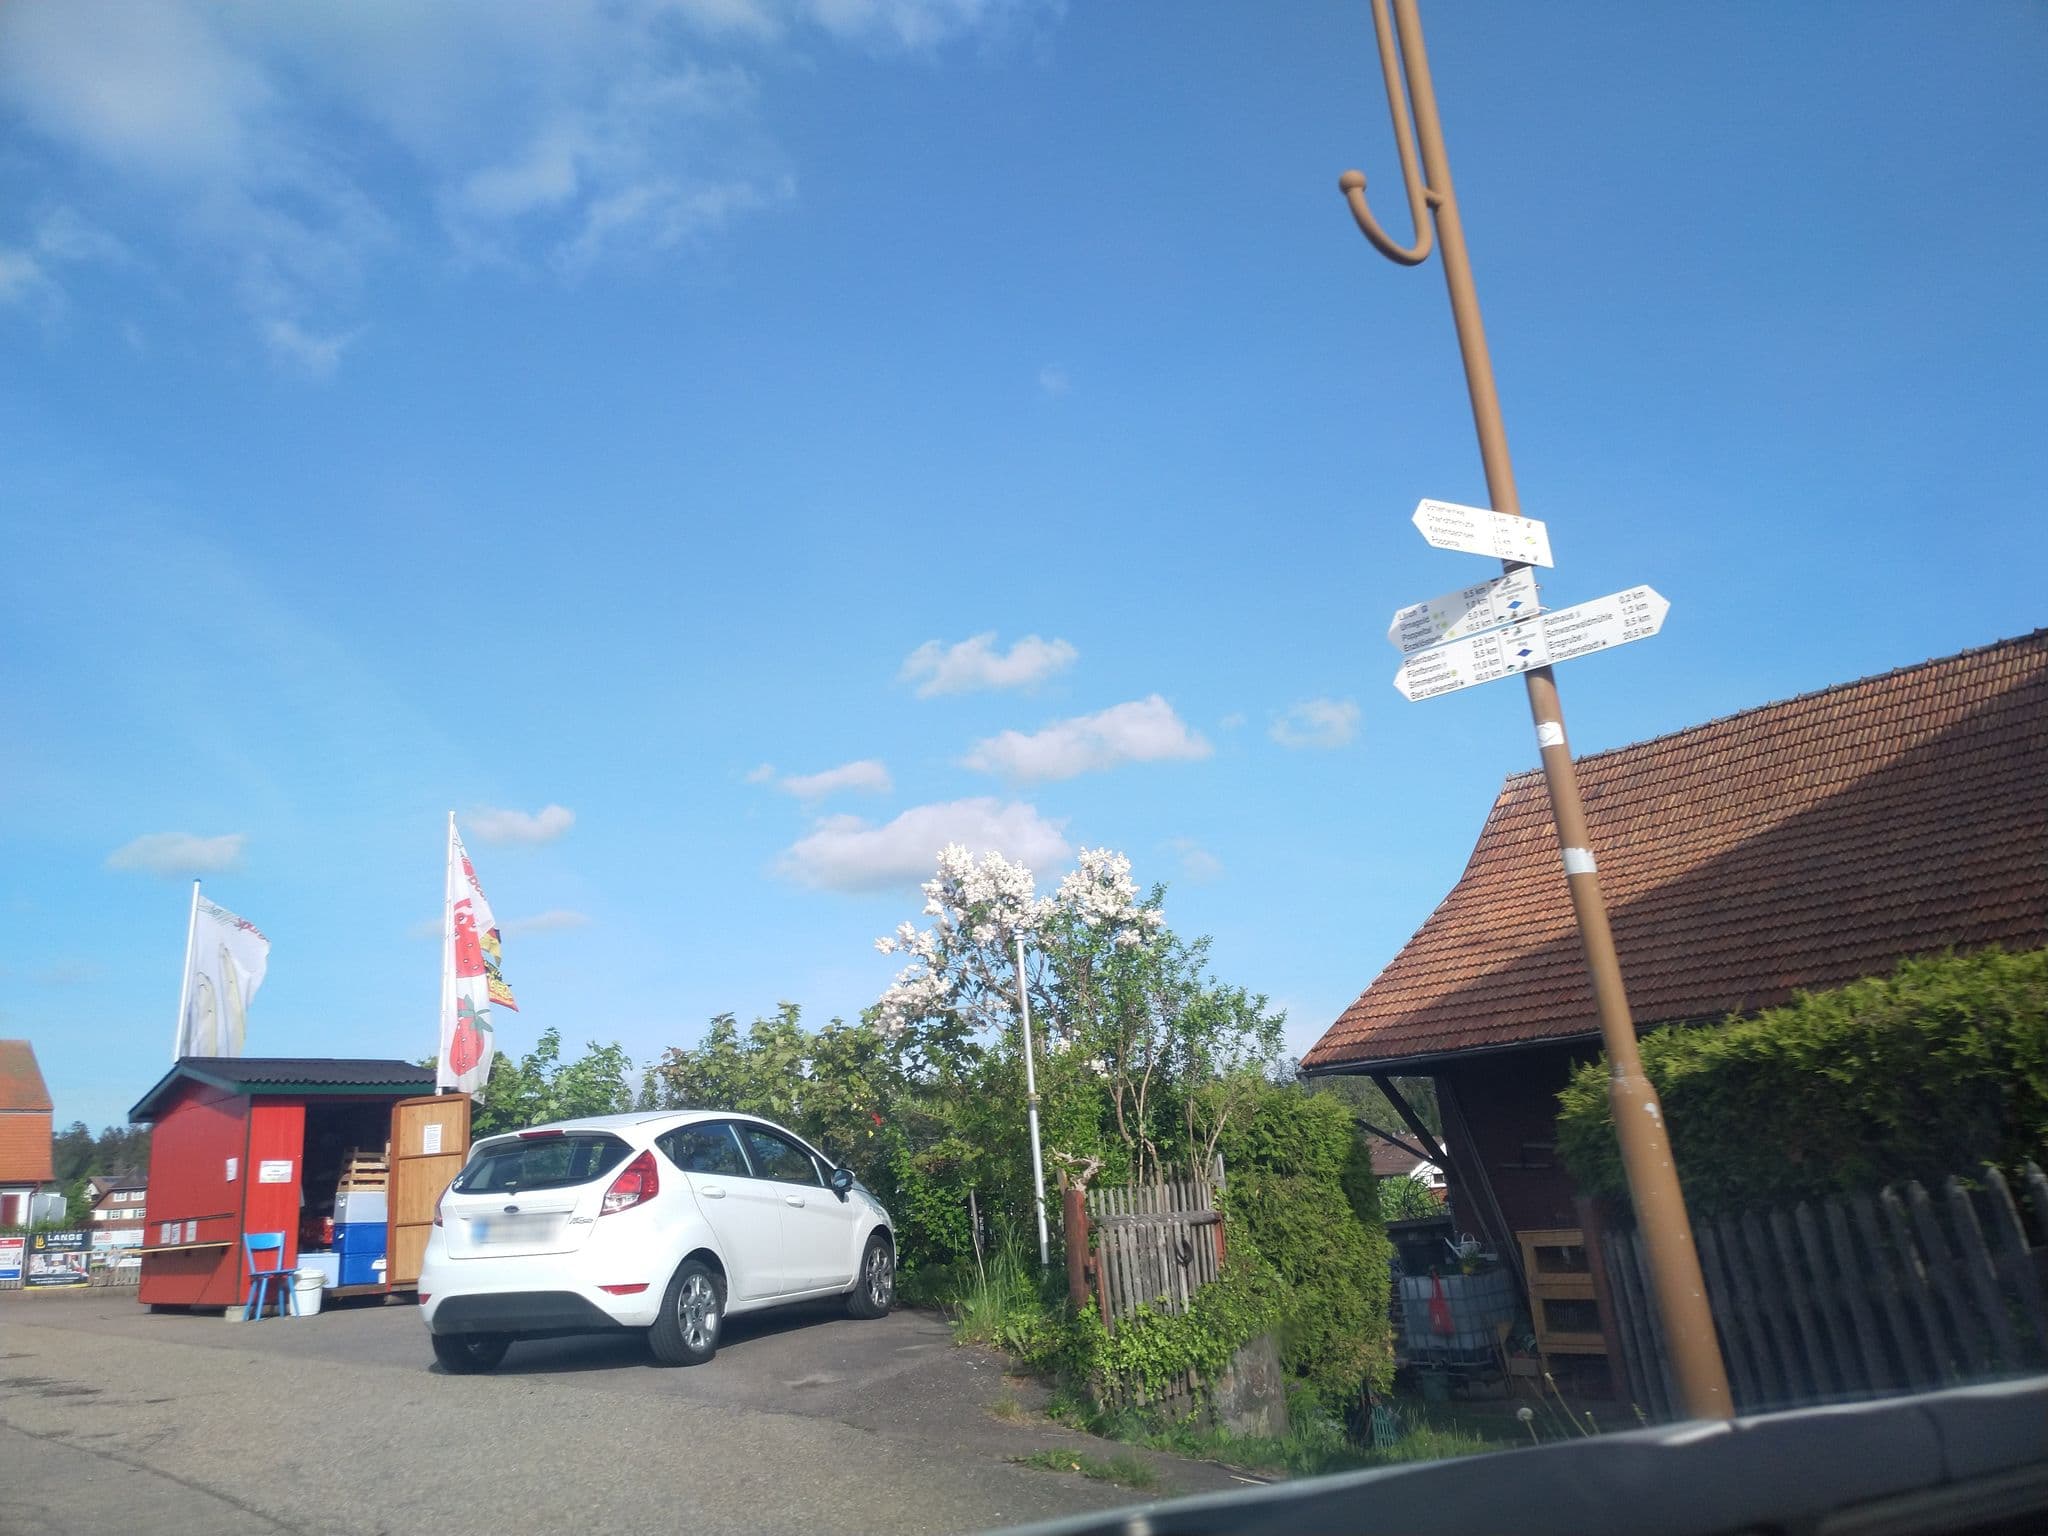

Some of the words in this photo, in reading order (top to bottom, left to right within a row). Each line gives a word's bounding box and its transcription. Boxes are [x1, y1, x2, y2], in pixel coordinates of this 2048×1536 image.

[1476, 586, 1487, 595] km
[1480, 607, 1490, 616] km
[1544, 612, 1574, 626] Rathaus
[1633, 590, 1646, 599] km
[1482, 618, 1492, 627] km
[1546, 612, 1614, 638] Schwarzwaldmühle
[1636, 602, 1648, 611] km
[1639, 614, 1651, 622] km
[1485, 635, 1496, 644] km
[1550, 640, 1599, 660] Freudenstadt
[1641, 625, 1654, 634] km
[1487, 646, 1498, 655] km
[1489, 657, 1500, 666] km
[1410, 690, 1424, 700] Bad
[1491, 669, 1502, 677] km
[48, 1233, 83, 1241] LANGE
